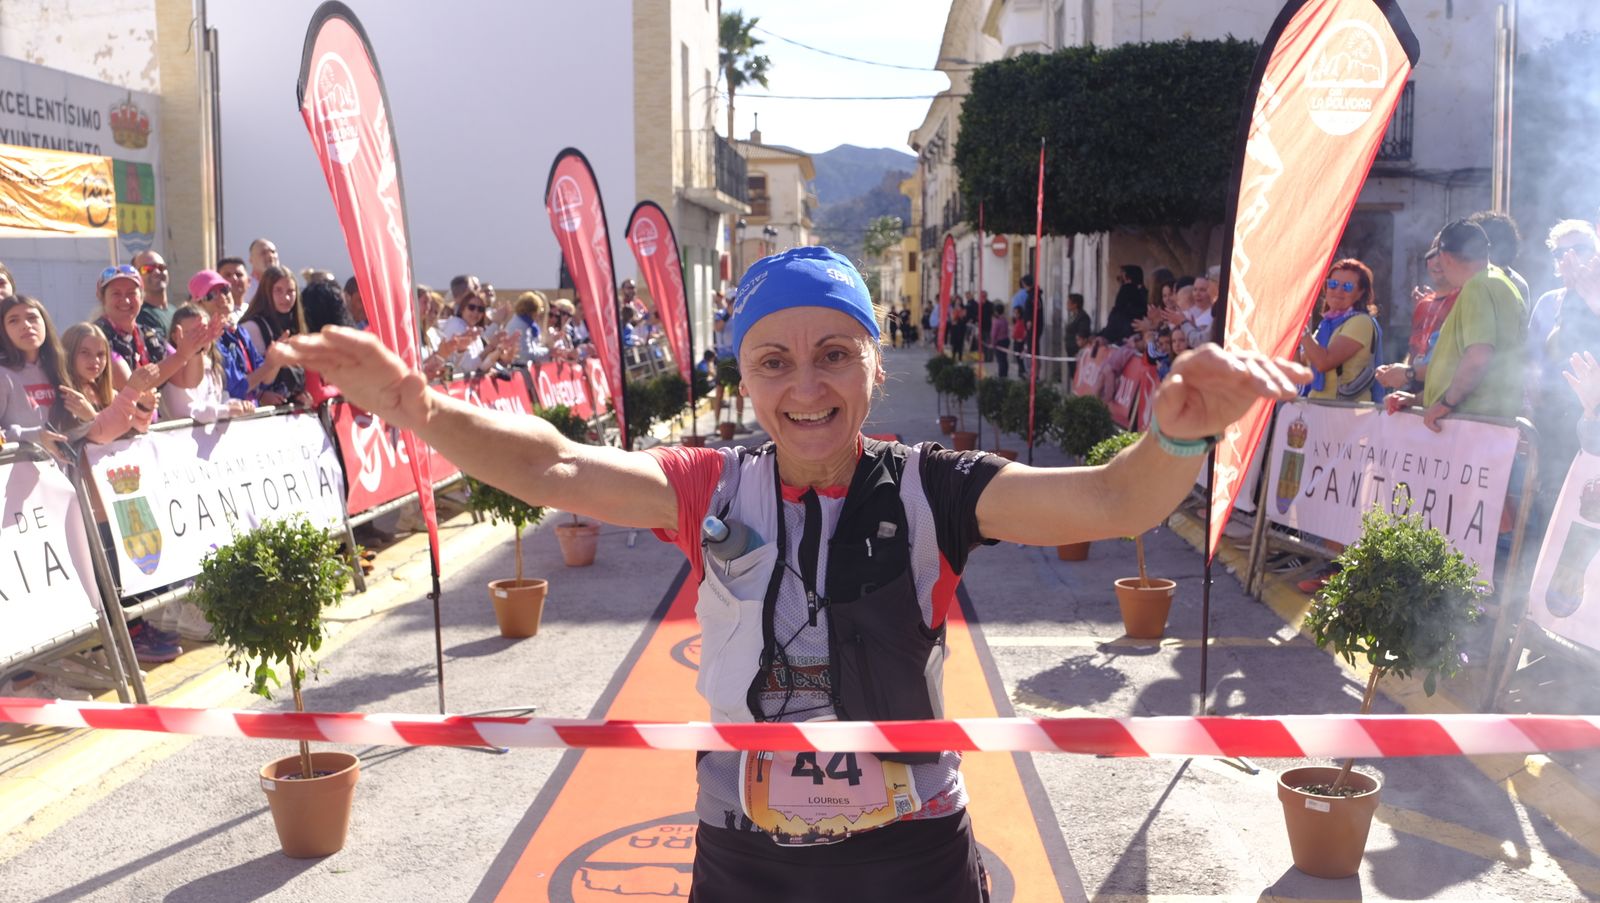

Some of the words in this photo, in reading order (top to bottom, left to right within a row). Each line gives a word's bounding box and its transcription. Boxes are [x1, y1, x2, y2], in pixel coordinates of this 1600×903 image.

[1461, 464, 1490, 489] DE
[169, 466, 333, 537] CANTORIA
[1304, 466, 1485, 545] CANTORIA
[14, 506, 48, 534] DE
[791, 751, 863, 786] 44
[808, 796, 850, 805] LOURDES
